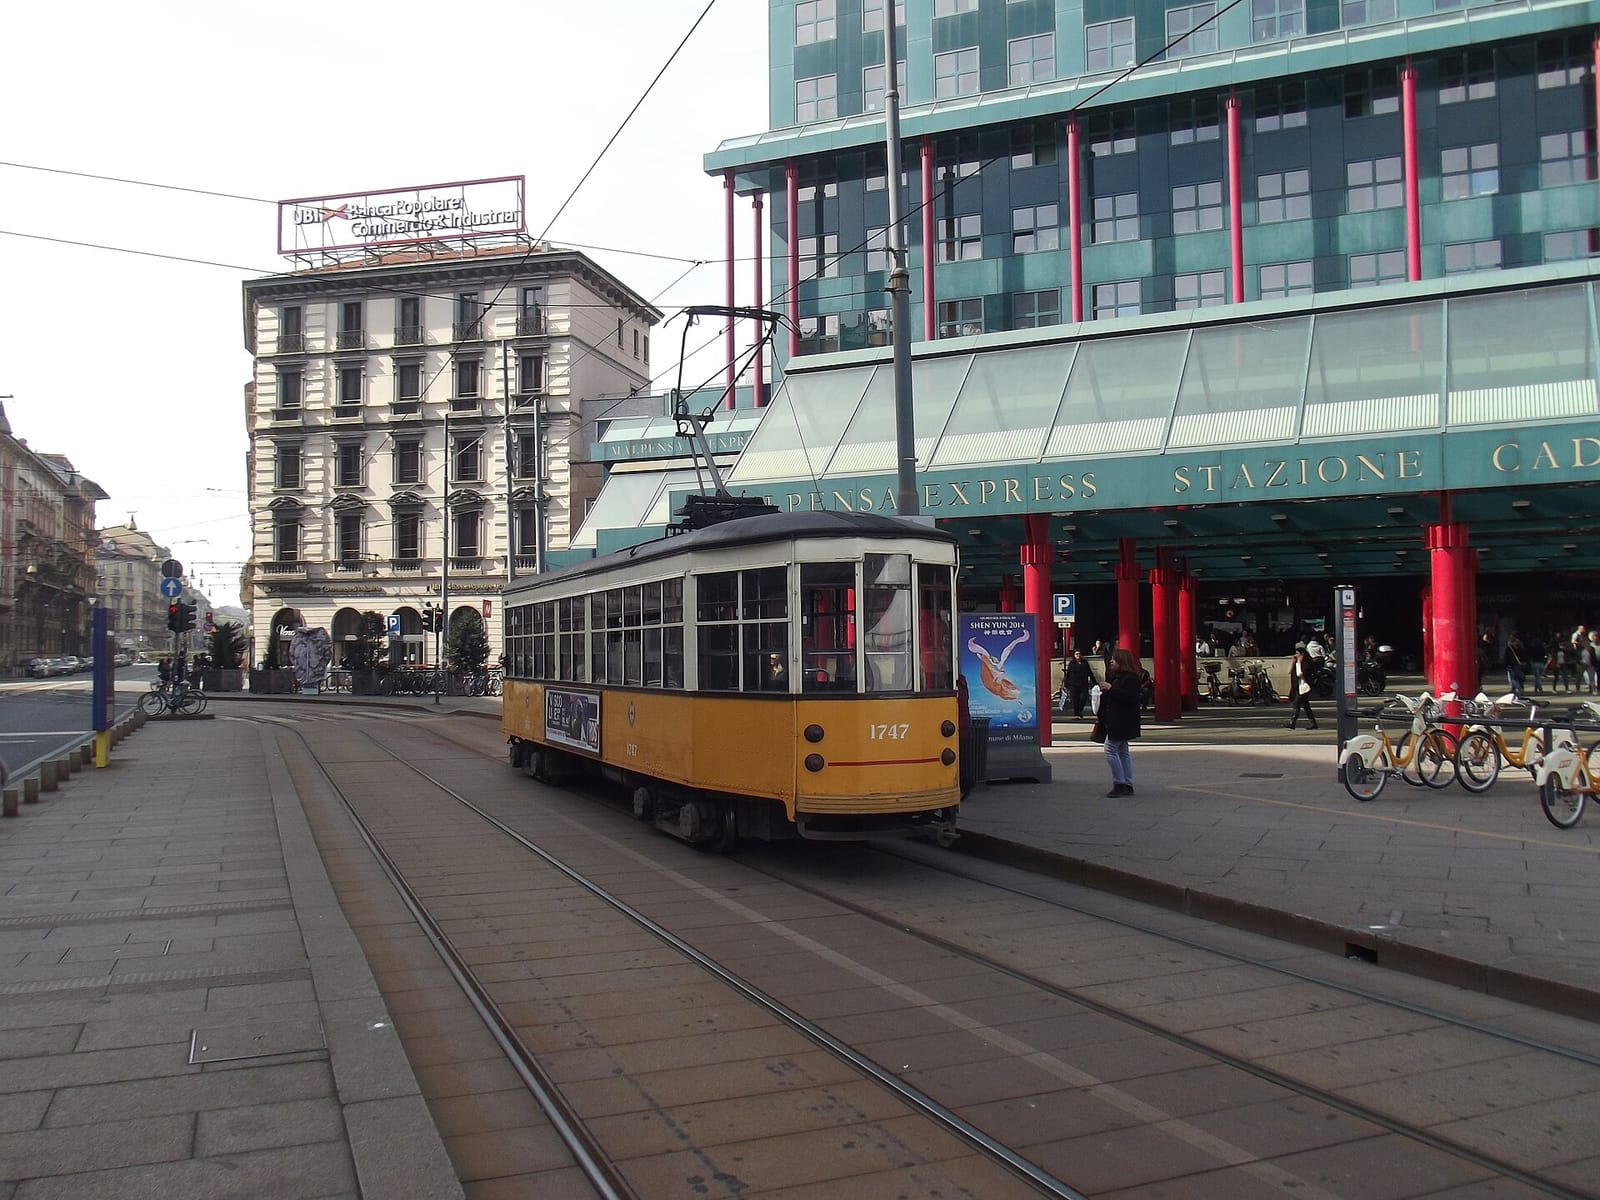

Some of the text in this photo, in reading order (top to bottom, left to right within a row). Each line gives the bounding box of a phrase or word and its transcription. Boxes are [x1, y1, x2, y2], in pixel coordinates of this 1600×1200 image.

[351, 196, 464, 219] Banca Popolare
[294, 208, 320, 225] UBI
[351, 217, 435, 238] Commercio
[450, 210, 520, 229] Industria
[708, 435, 748, 449] EXPR
[922, 472, 1097, 508] EXPRESS
[1173, 450, 1424, 493] STAZIONE
[1492, 437, 1600, 473] CAD
[1058, 597, 1070, 613] P
[389, 617, 397, 630] P
[970, 621, 1025, 629] SHEN YUN 2014
[870, 724, 910, 740] 1747
